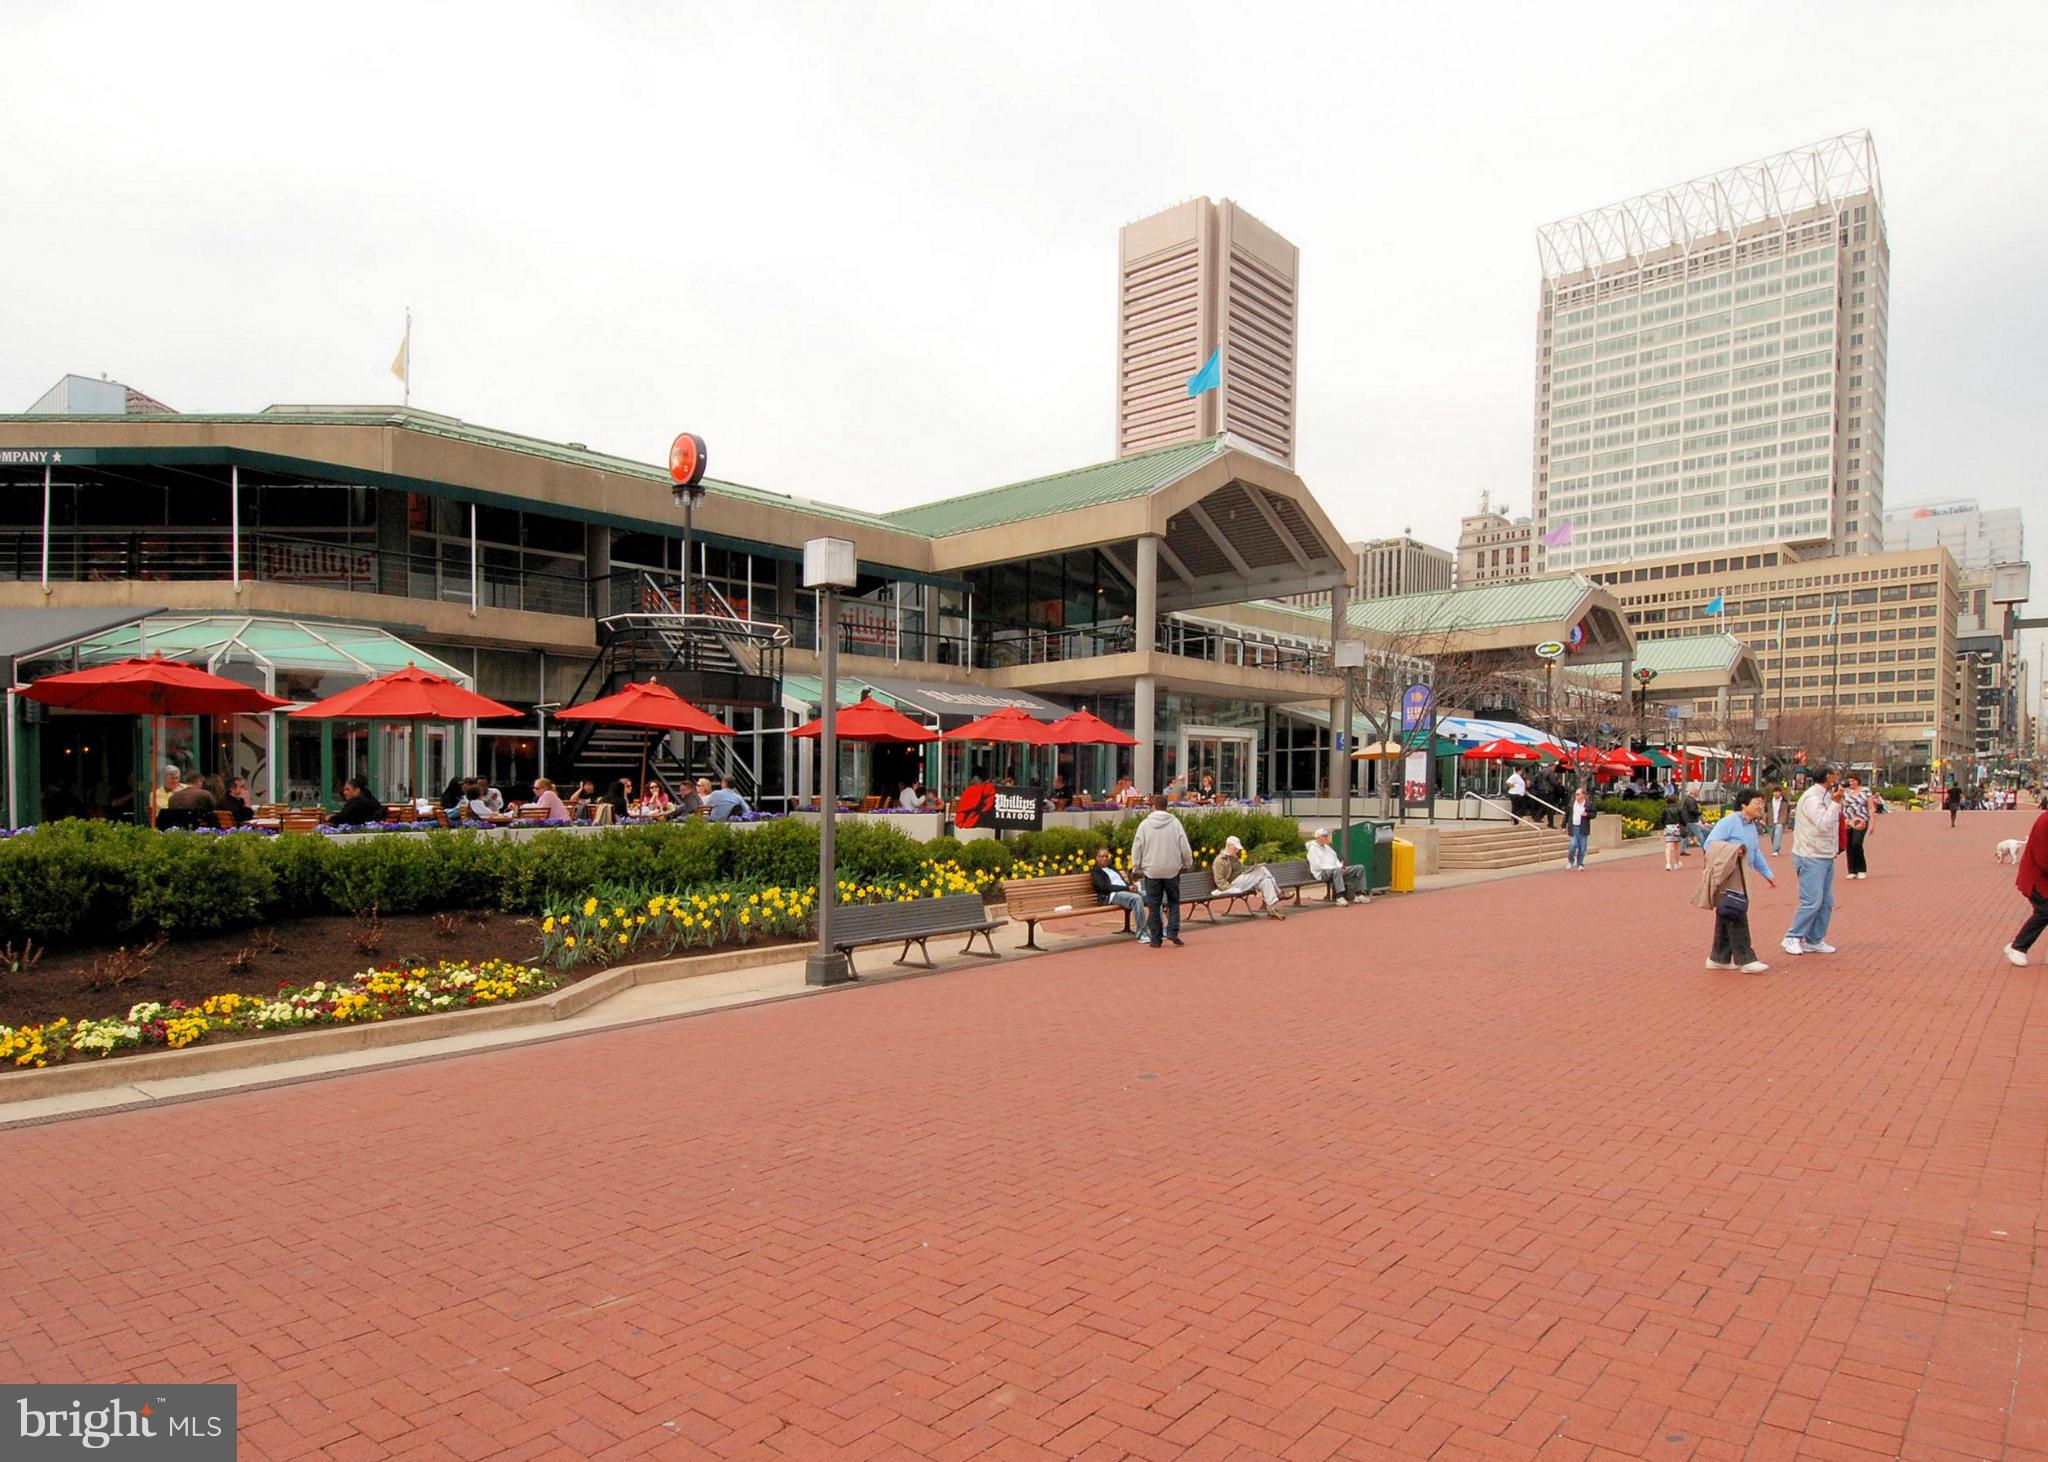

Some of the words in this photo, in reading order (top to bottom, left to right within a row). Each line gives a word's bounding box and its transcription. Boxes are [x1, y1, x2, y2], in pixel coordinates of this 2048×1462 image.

[263, 544, 371, 578] Phillips
[995, 793, 1035, 811] Phillips
[995, 811, 1035, 820] SEAFOOD
